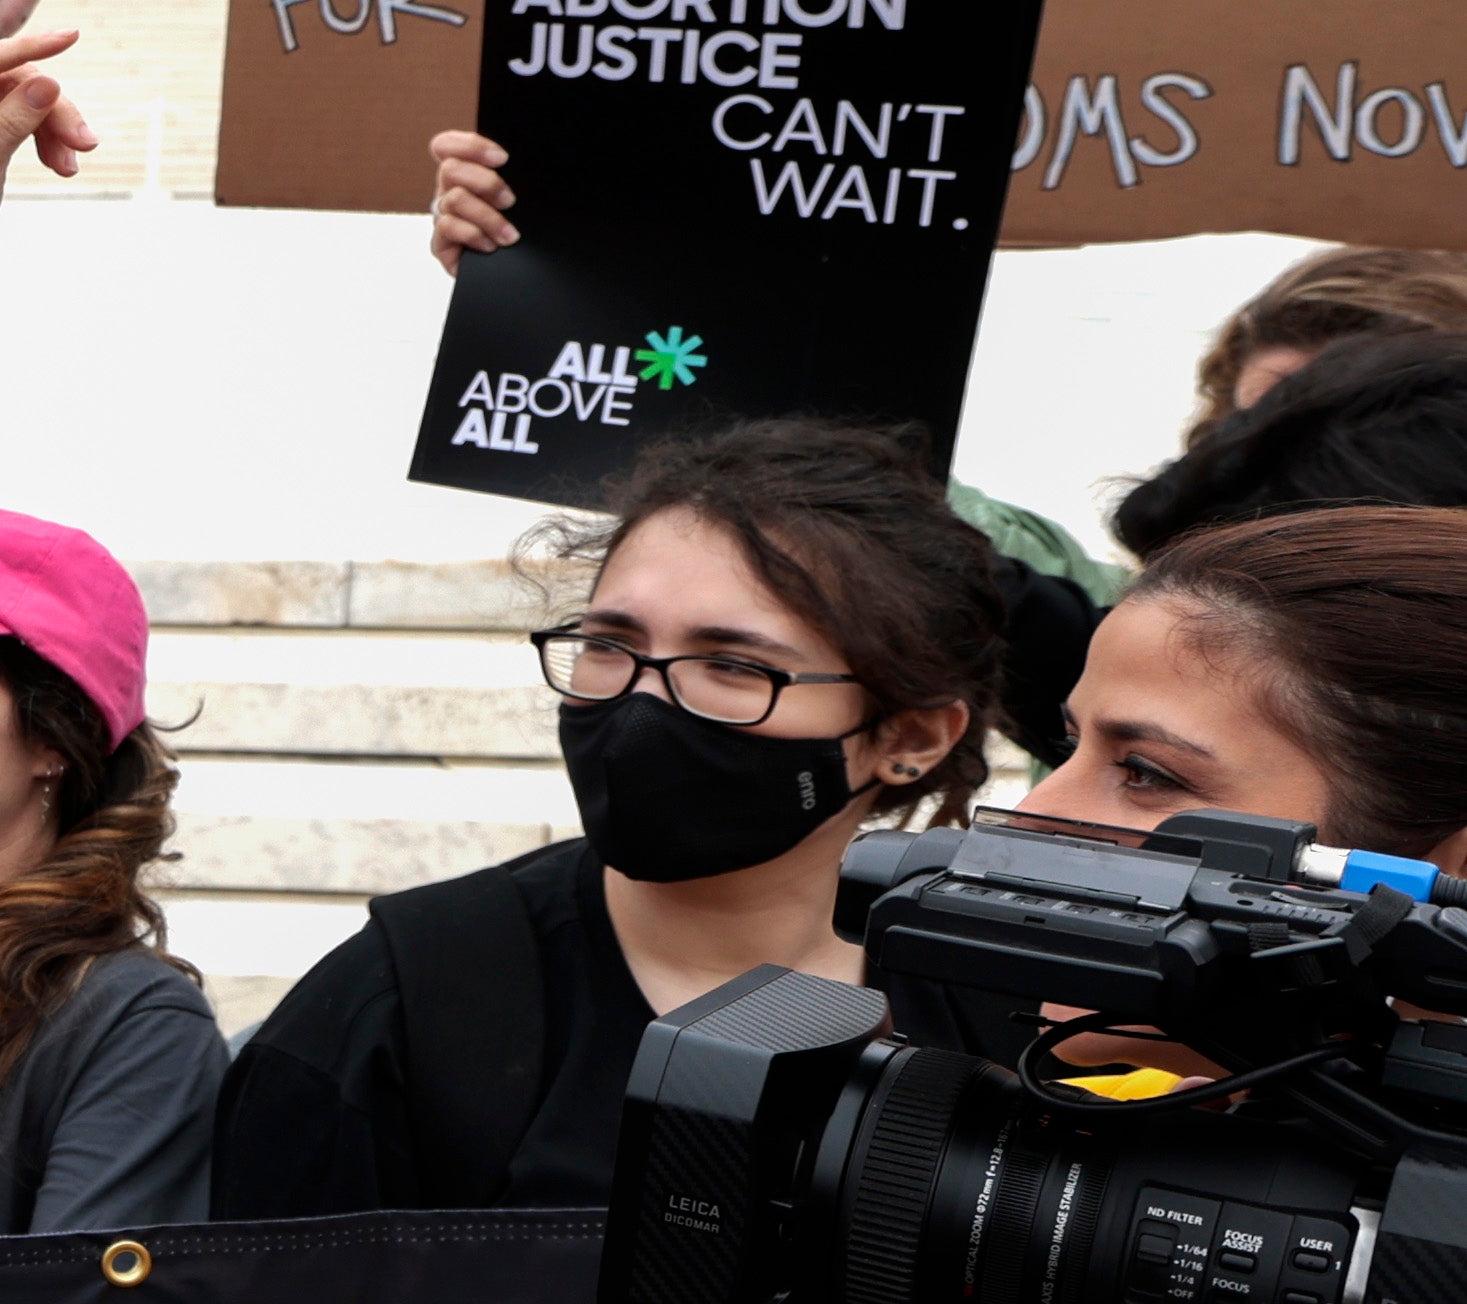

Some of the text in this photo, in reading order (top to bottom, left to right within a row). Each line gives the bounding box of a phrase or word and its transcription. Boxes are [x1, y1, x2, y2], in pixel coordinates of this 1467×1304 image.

[507, 22, 803, 90] JUSTICE
[711, 93, 966, 163] CAN'T
[749, 158, 970, 231] WAIT.
[548, 340, 639, 387] ALL
[457, 370, 637, 426] ABOVE
[450, 407, 540, 455] ALL
[669, 1194, 721, 1219] LEICA
[1059, 1162, 1083, 1211] STABILIZER
[1053, 1210, 1070, 1244] IMAGE
[1147, 1206, 1204, 1227] ND FILTER
[1221, 1238, 1262, 1254] ASSIST
[1223, 1228, 1264, 1246] FOCUS
[1299, 1236, 1334, 1253] USER
[1212, 1277, 1251, 1294] FOCUS
